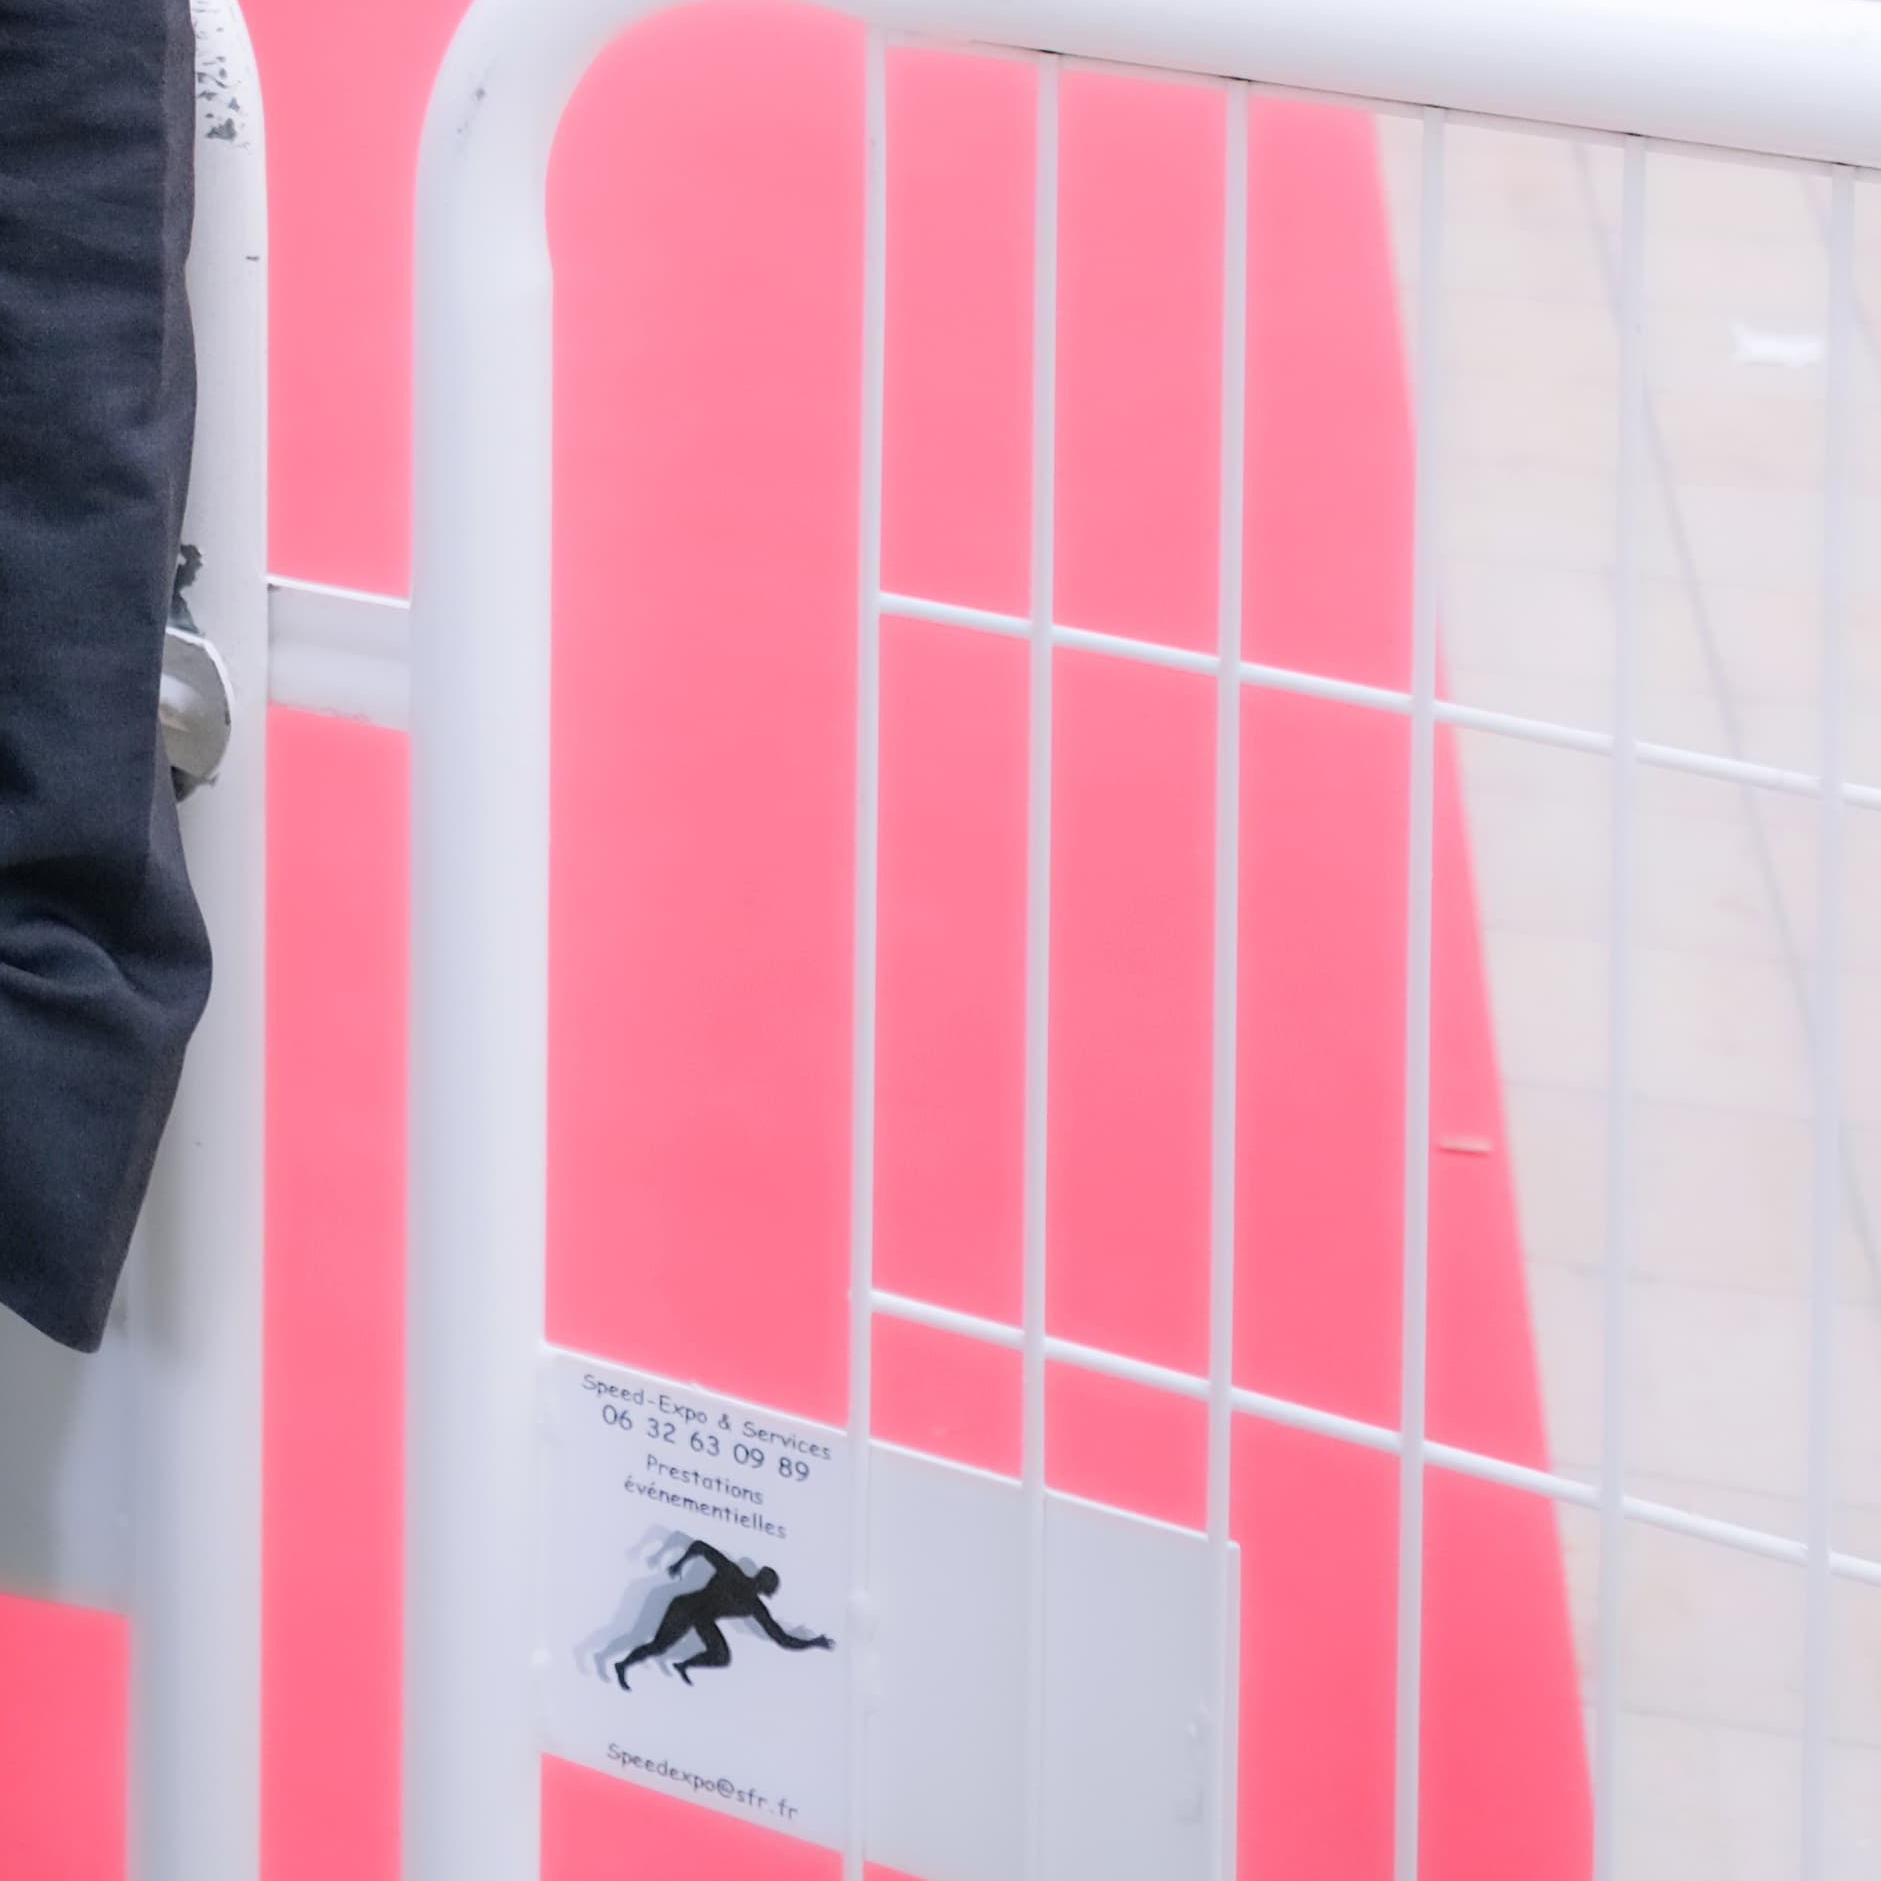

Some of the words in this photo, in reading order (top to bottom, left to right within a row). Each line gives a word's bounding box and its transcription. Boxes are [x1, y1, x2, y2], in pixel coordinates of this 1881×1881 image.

[583, 1373, 708, 1424] Speed-Expo
[718, 1413, 731, 1432] &
[742, 1421, 832, 1461] Services
[602, 1404, 633, 1431] 06
[647, 1417, 676, 1444] 32
[690, 1431, 720, 1457] 63
[733, 1443, 765, 1469] 09
[778, 1456, 810, 1482] 89
[624, 1475, 787, 1540] événementielles
[646, 1454, 764, 1505] Prestations
[607, 1742, 799, 1820] Speedexpo@sfr.fr
